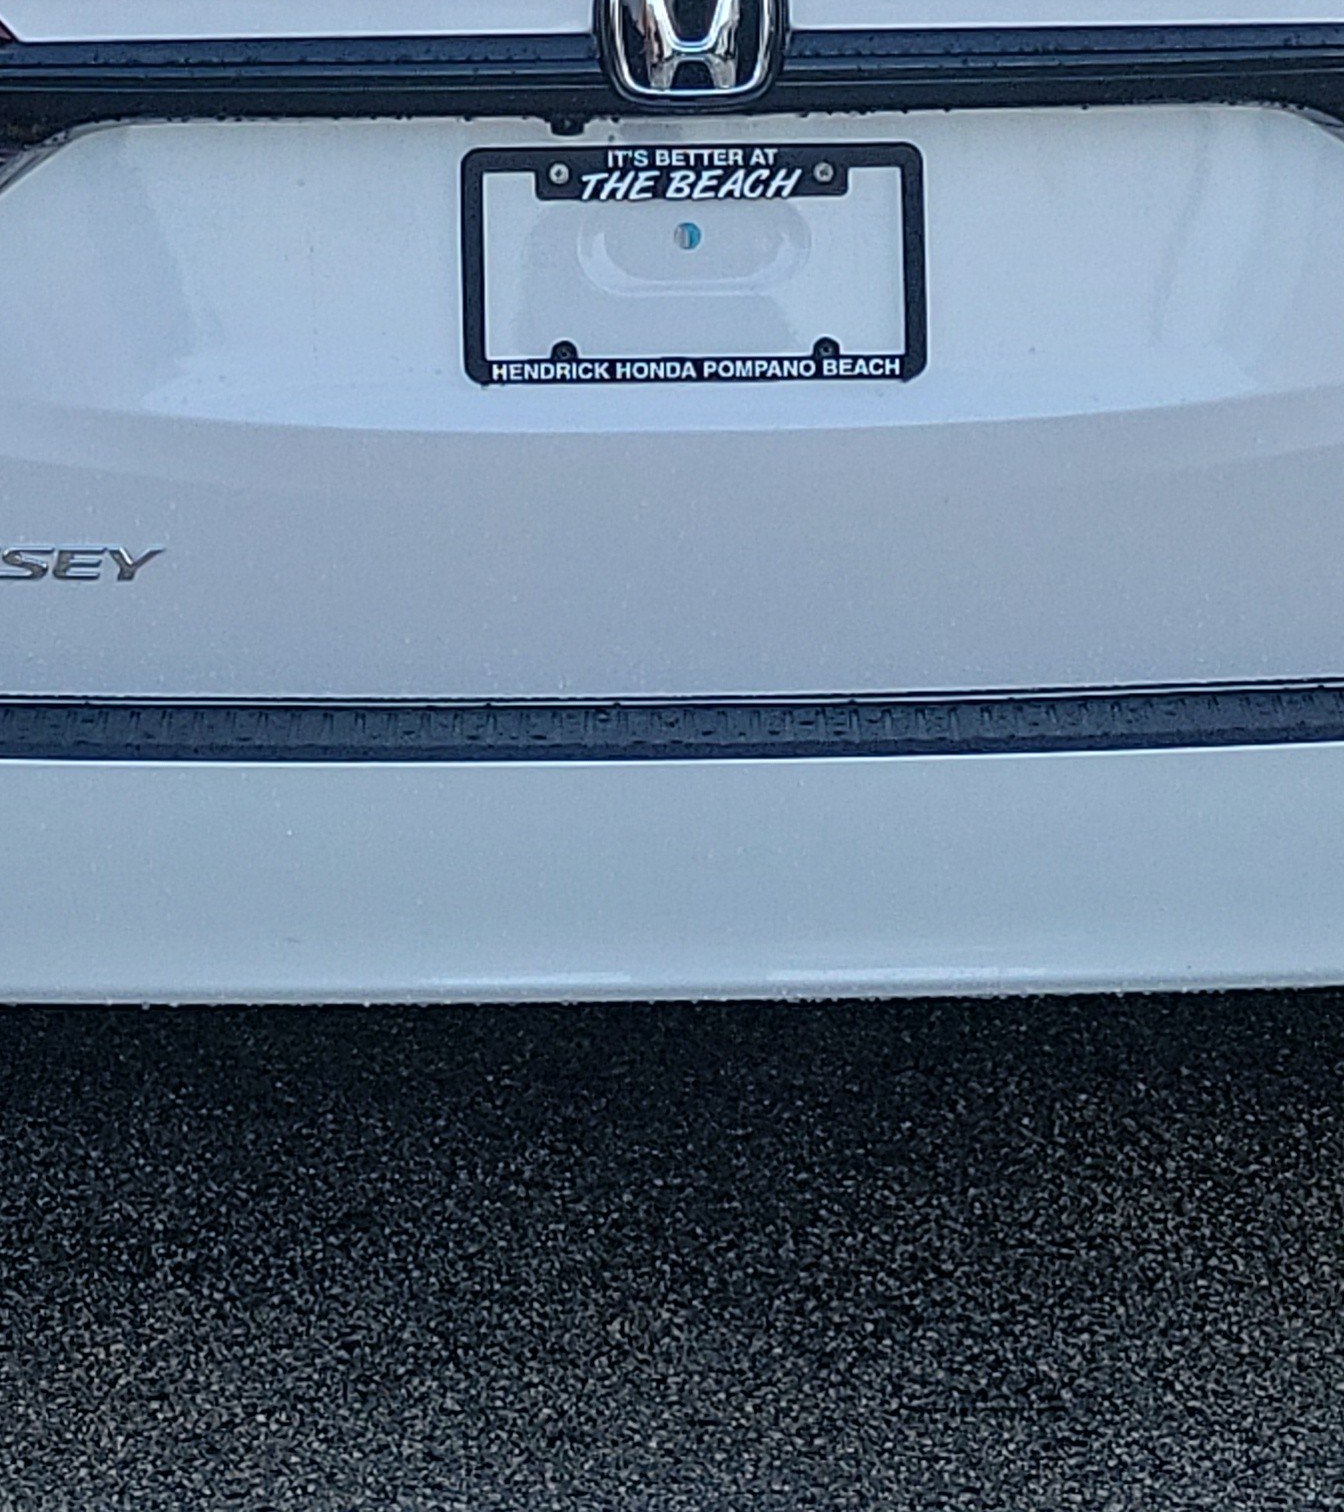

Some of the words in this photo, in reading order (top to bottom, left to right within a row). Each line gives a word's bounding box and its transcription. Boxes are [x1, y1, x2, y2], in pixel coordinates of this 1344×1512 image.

[607, 150, 649, 168] IT'S
[655, 148, 744, 167] BETTER
[749, 148, 779, 166] AT
[580, 169, 661, 201] THE
[665, 167, 804, 200] BEACH
[492, 362, 610, 381] HENDRICK
[615, 361, 697, 380] HONDA
[703, 359, 816, 378] POMPANO
[822, 357, 900, 376] BEACH
